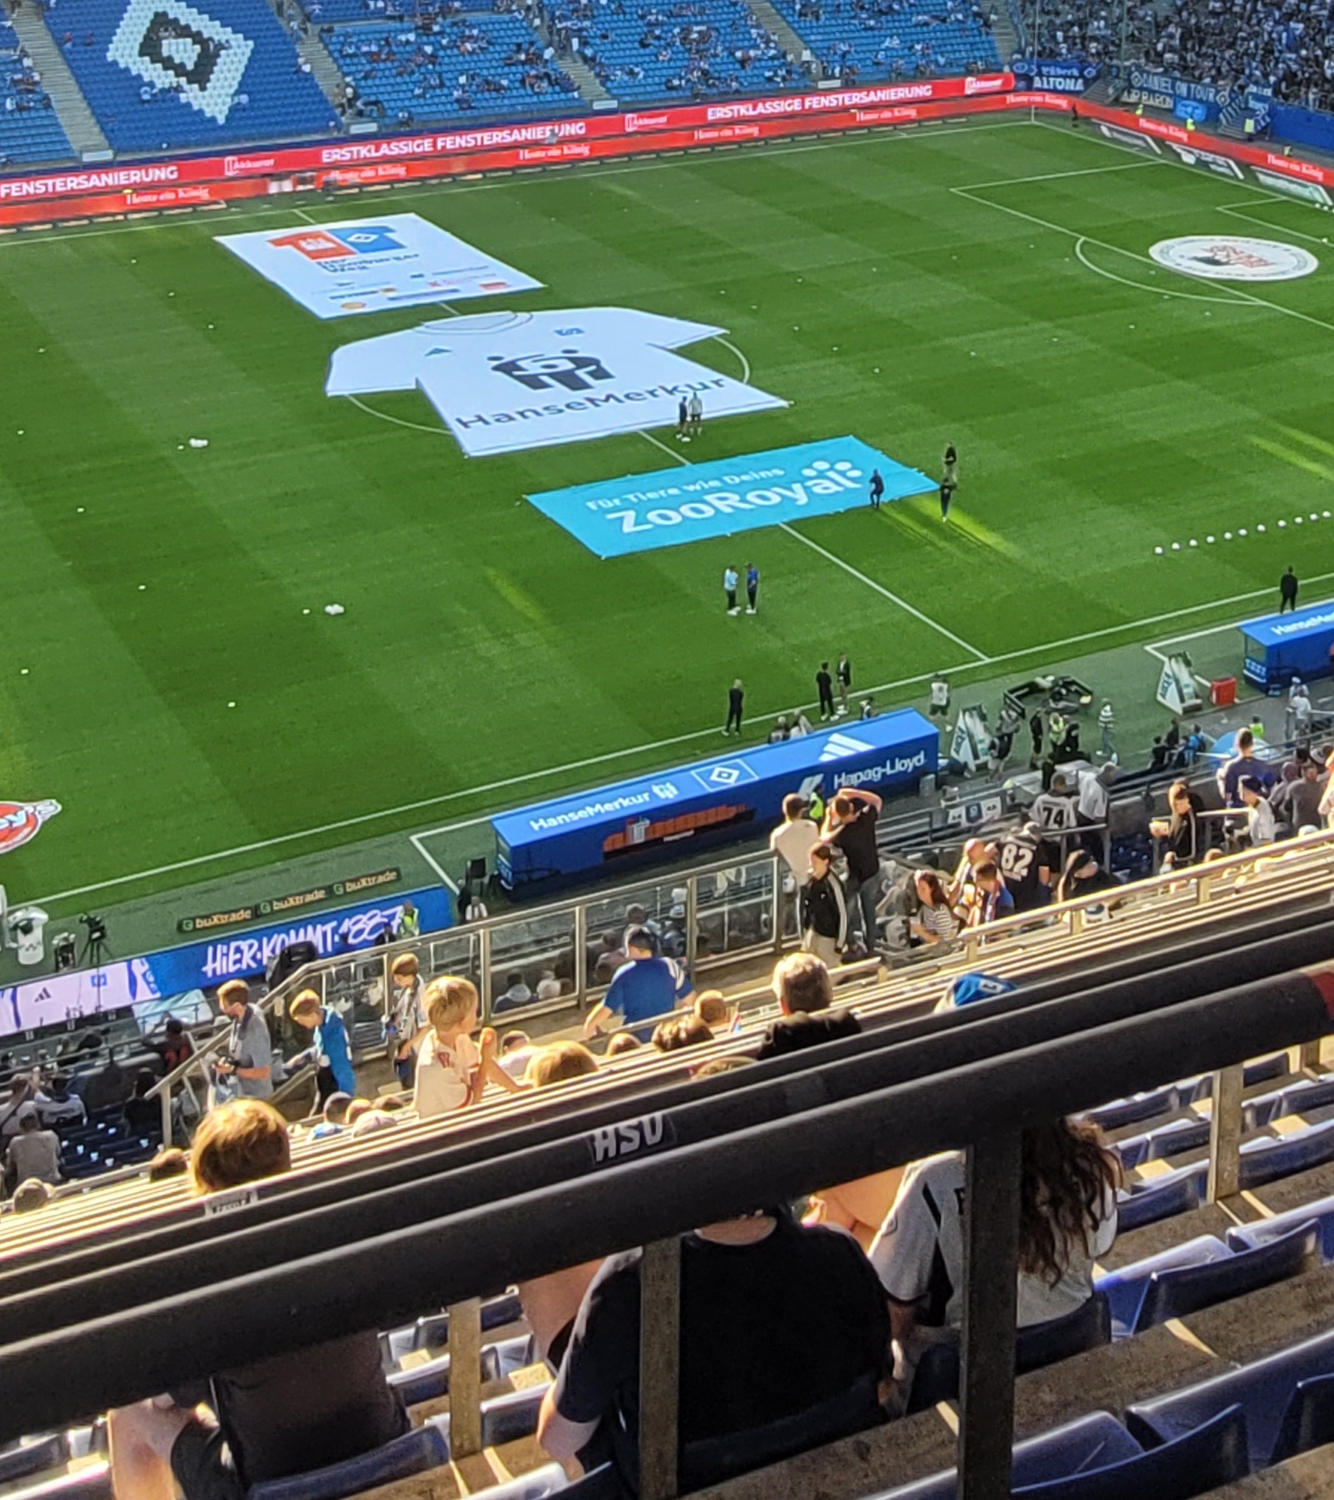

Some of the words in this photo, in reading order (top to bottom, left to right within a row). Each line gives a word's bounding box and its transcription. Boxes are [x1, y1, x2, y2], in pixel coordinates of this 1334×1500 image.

[1033, 76, 1084, 91] ALTONA
[707, 99, 803, 121] ERSTKLASSIGE
[804, 85, 932, 110] FENSTERSANIERUNG
[322, 138, 434, 164] ERSTKLASSIGE
[0, 166, 179, 198] FENSTERSANIERUNG
[455, 376, 728, 430] HanseMerkur
[585, 496, 625, 512] Für
[628, 484, 682, 505] Tiere
[683, 477, 723, 494] wie
[723, 465, 786, 486] Deins
[606, 467, 864, 535] ZooRoyal
[832, 749, 927, 790] Hapag-Lloyd
[528, 789, 652, 832] HanseMerkur
[1041, 805, 1065, 828] 74
[1000, 843, 1034, 875] 82
[593, 1112, 664, 1162] HSV
